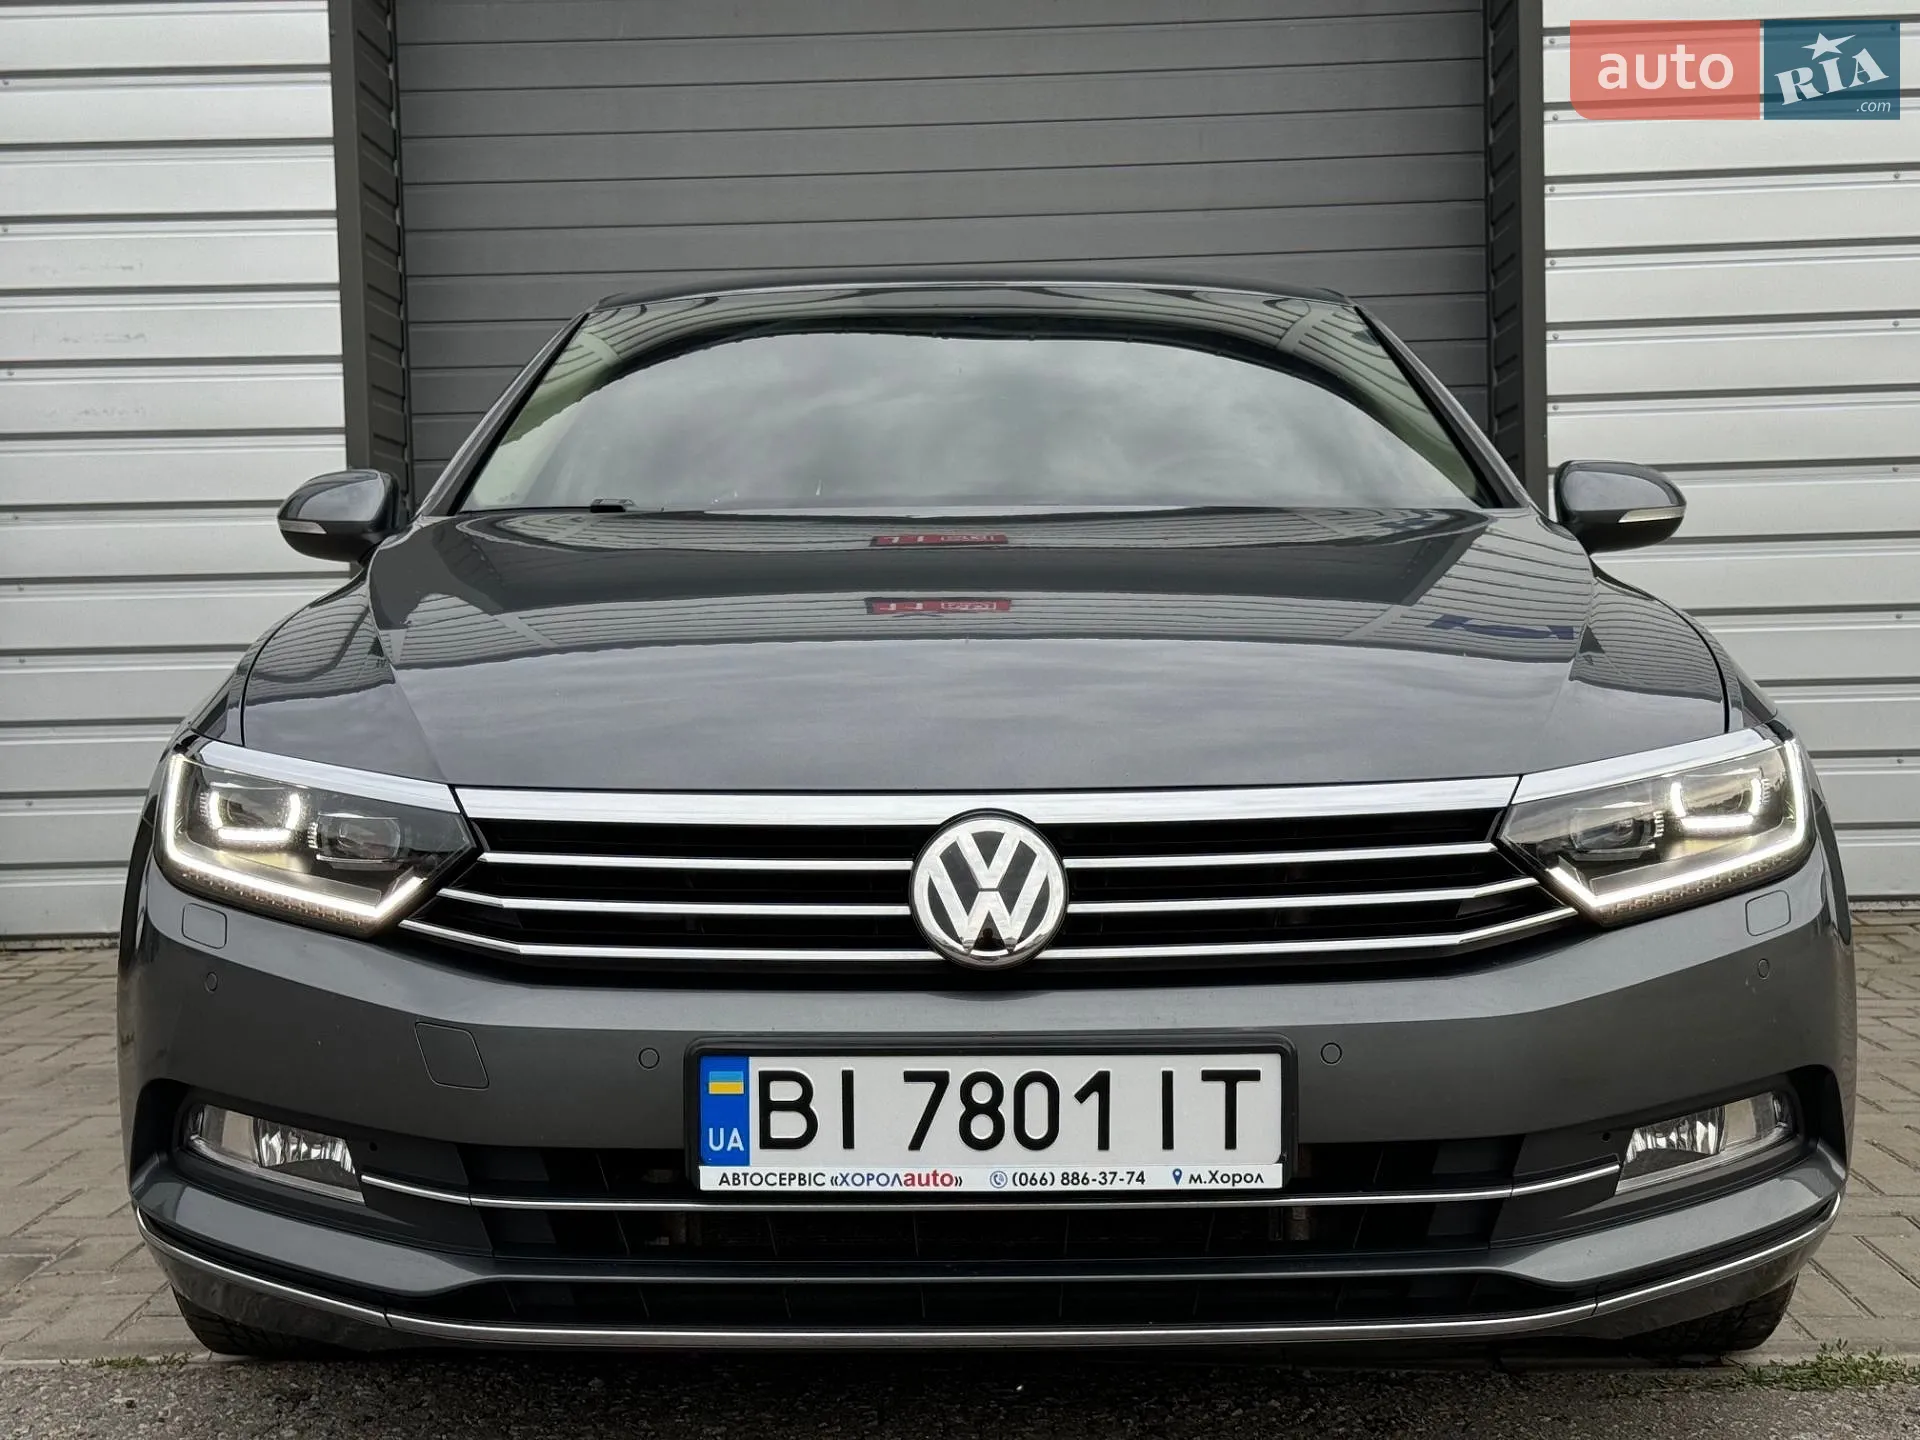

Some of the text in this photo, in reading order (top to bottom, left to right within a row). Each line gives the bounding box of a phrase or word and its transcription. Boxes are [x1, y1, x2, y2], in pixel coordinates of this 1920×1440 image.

[757, 1069, 1261, 1151] BI 7801 IT
[708, 1127, 744, 1152] UA
[718, 1172, 826, 1187] АВТОСЕРВІС
[1012, 1170, 1146, 1187] (066) 886-37-74
[1188, 1169, 1265, 1187] м.Хорол
